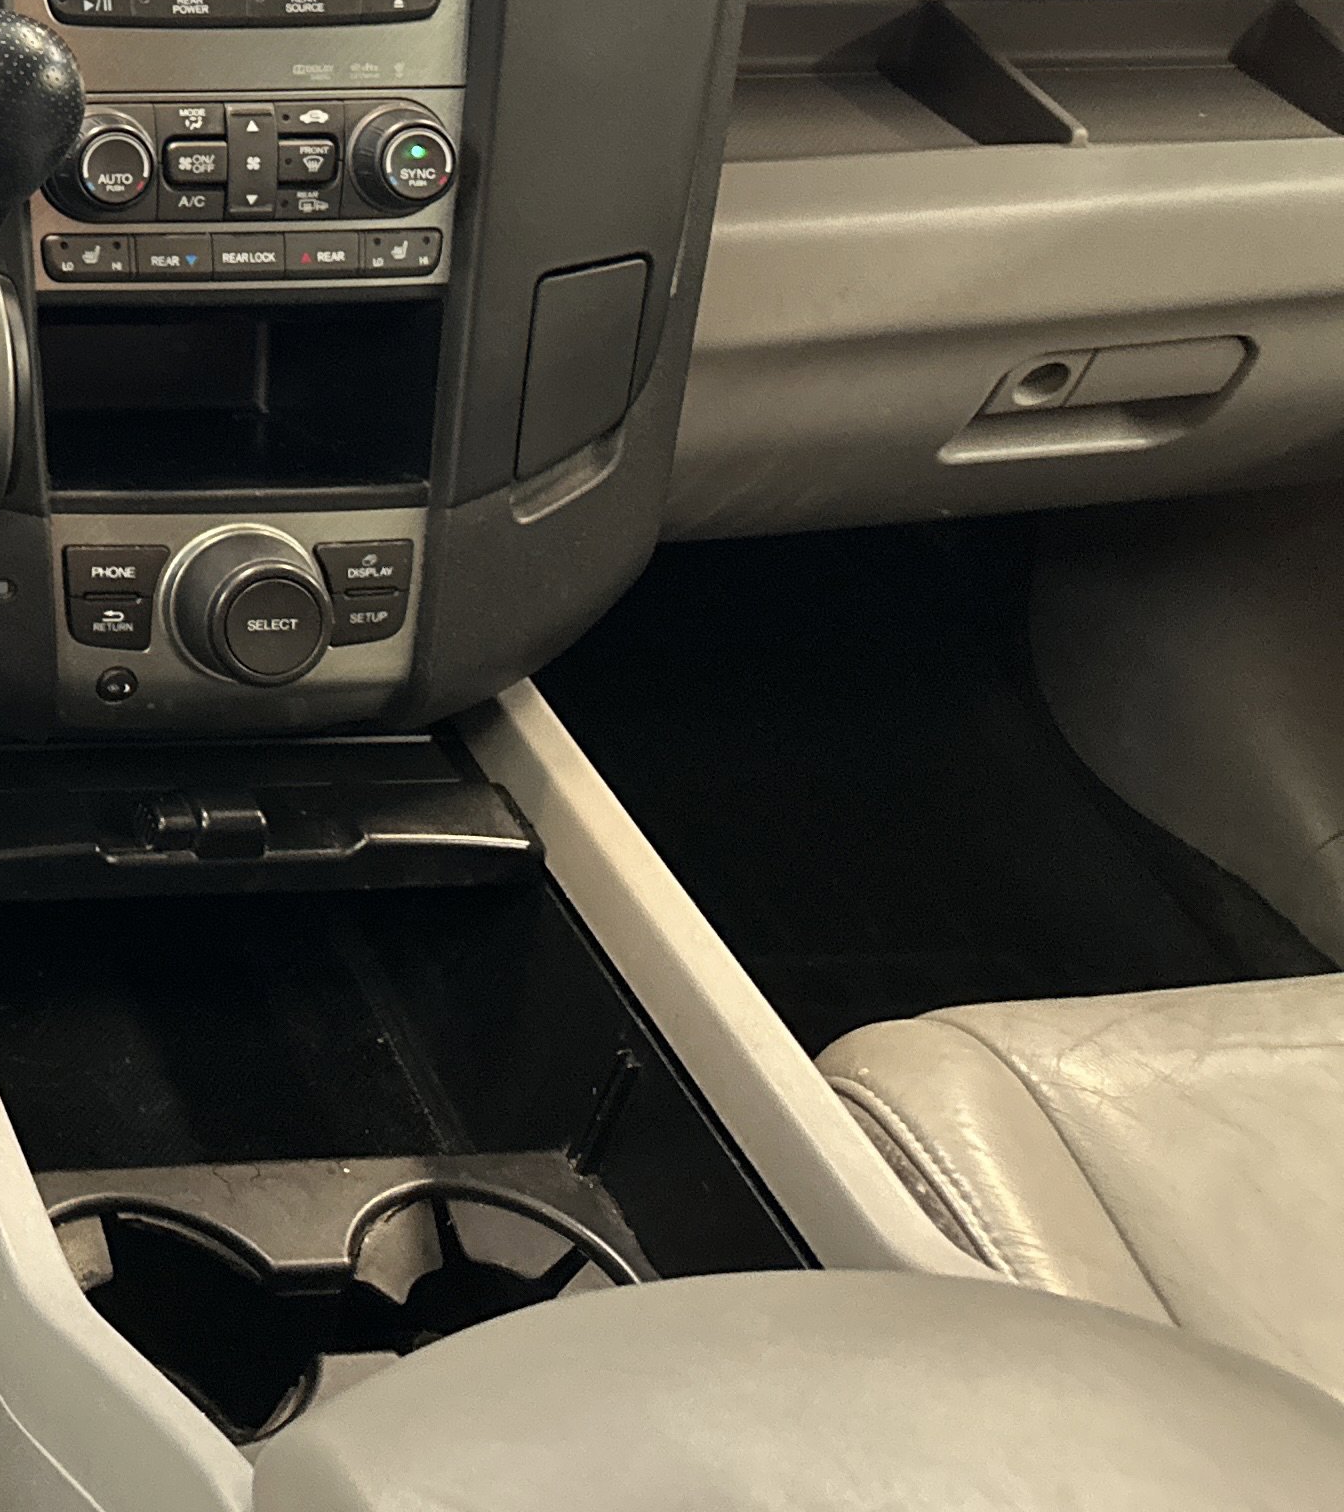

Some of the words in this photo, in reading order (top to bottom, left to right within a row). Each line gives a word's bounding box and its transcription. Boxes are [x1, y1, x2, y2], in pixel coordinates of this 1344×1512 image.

[172, 4, 209, 14] POWER
[285, 2, 325, 13] SOURCE
[179, 108, 206, 117] MODE
[299, 146, 330, 154] FRONT
[192, 163, 214, 174] OFF
[400, 168, 436, 180] SYNC
[98, 173, 133, 185] AUTO
[178, 195, 206, 208] A/C
[151, 255, 180, 268] REAR
[222, 252, 248, 264] REAR
[249, 251, 276, 263] LOCK
[317, 251, 345, 263] REAR
[372, 258, 384, 268] LO
[61, 261, 75, 272] LO
[91, 566, 136, 579] PHONE
[347, 566, 394, 578] DISPLAY
[349, 611, 389, 625] SETUP
[92, 621, 134, 633] RETURN
[247, 619, 299, 632] SELECT
